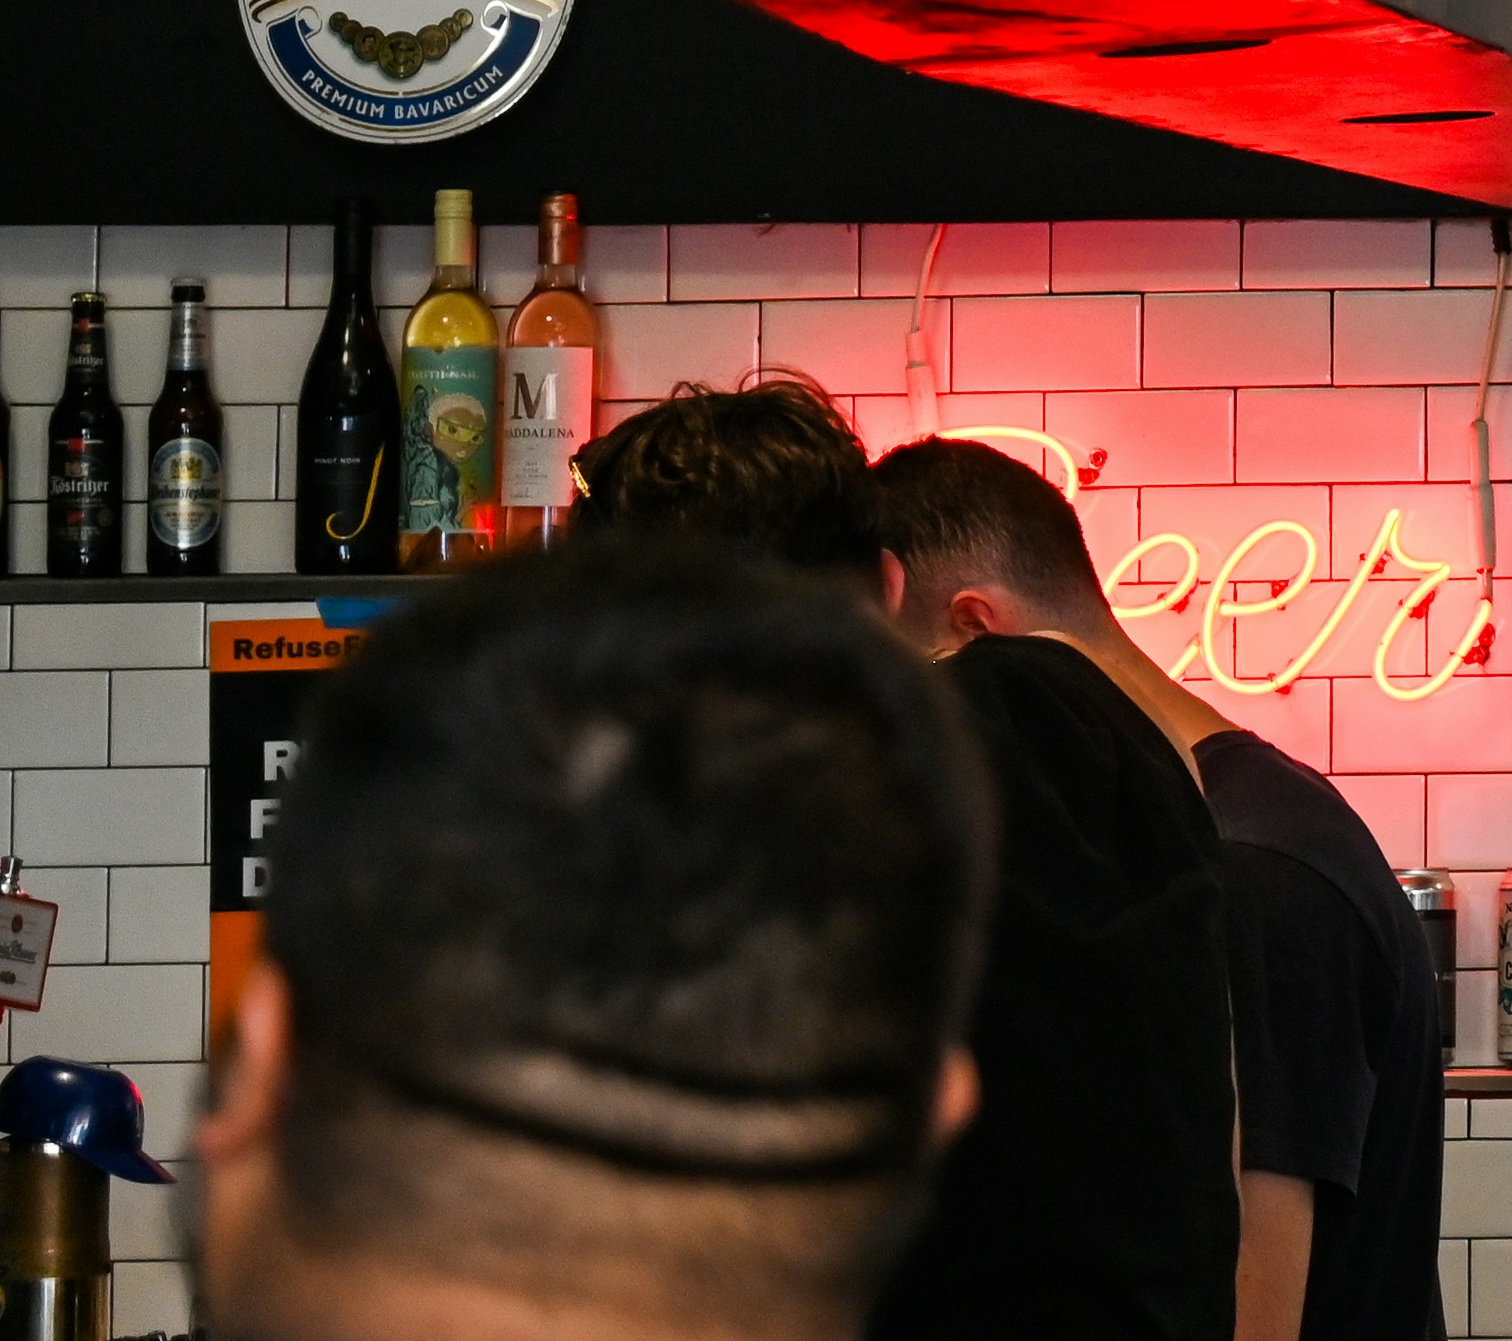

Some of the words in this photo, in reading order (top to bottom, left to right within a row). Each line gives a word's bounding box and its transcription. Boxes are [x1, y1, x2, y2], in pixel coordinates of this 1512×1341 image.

[301, 68, 386, 119] PREMIUM
[393, 64, 505, 120] BAVARICUM
[511, 372, 560, 421] M
